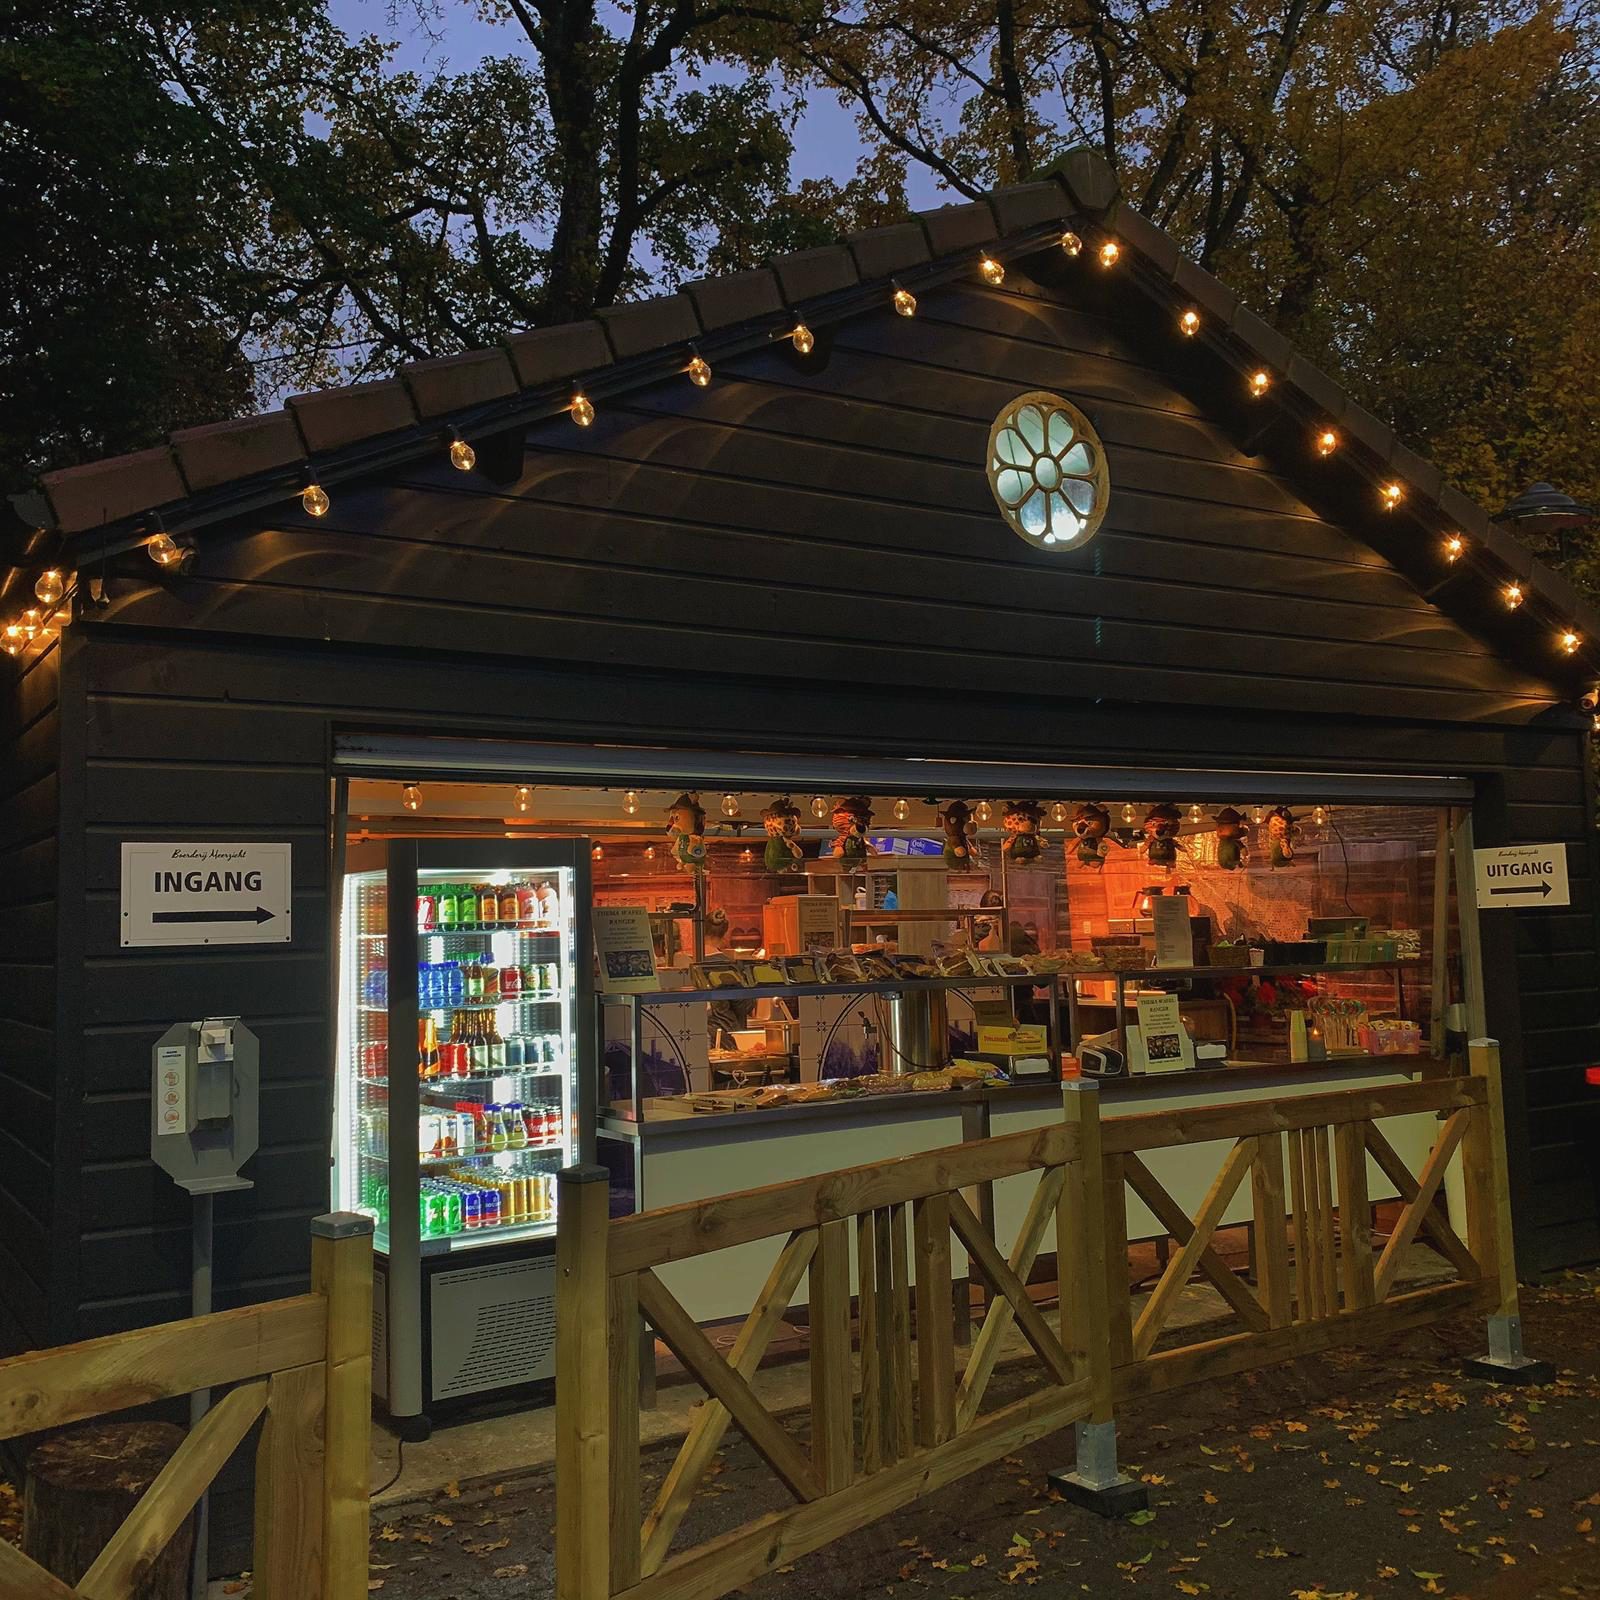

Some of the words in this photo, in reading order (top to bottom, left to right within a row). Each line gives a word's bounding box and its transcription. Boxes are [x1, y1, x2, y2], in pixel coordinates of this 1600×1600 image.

[171, 849, 208, 861] Boerderij
[208, 849, 247, 861] Meerzicht
[1487, 861, 1553, 876] UITGANG
[154, 871, 262, 892] INGANG
